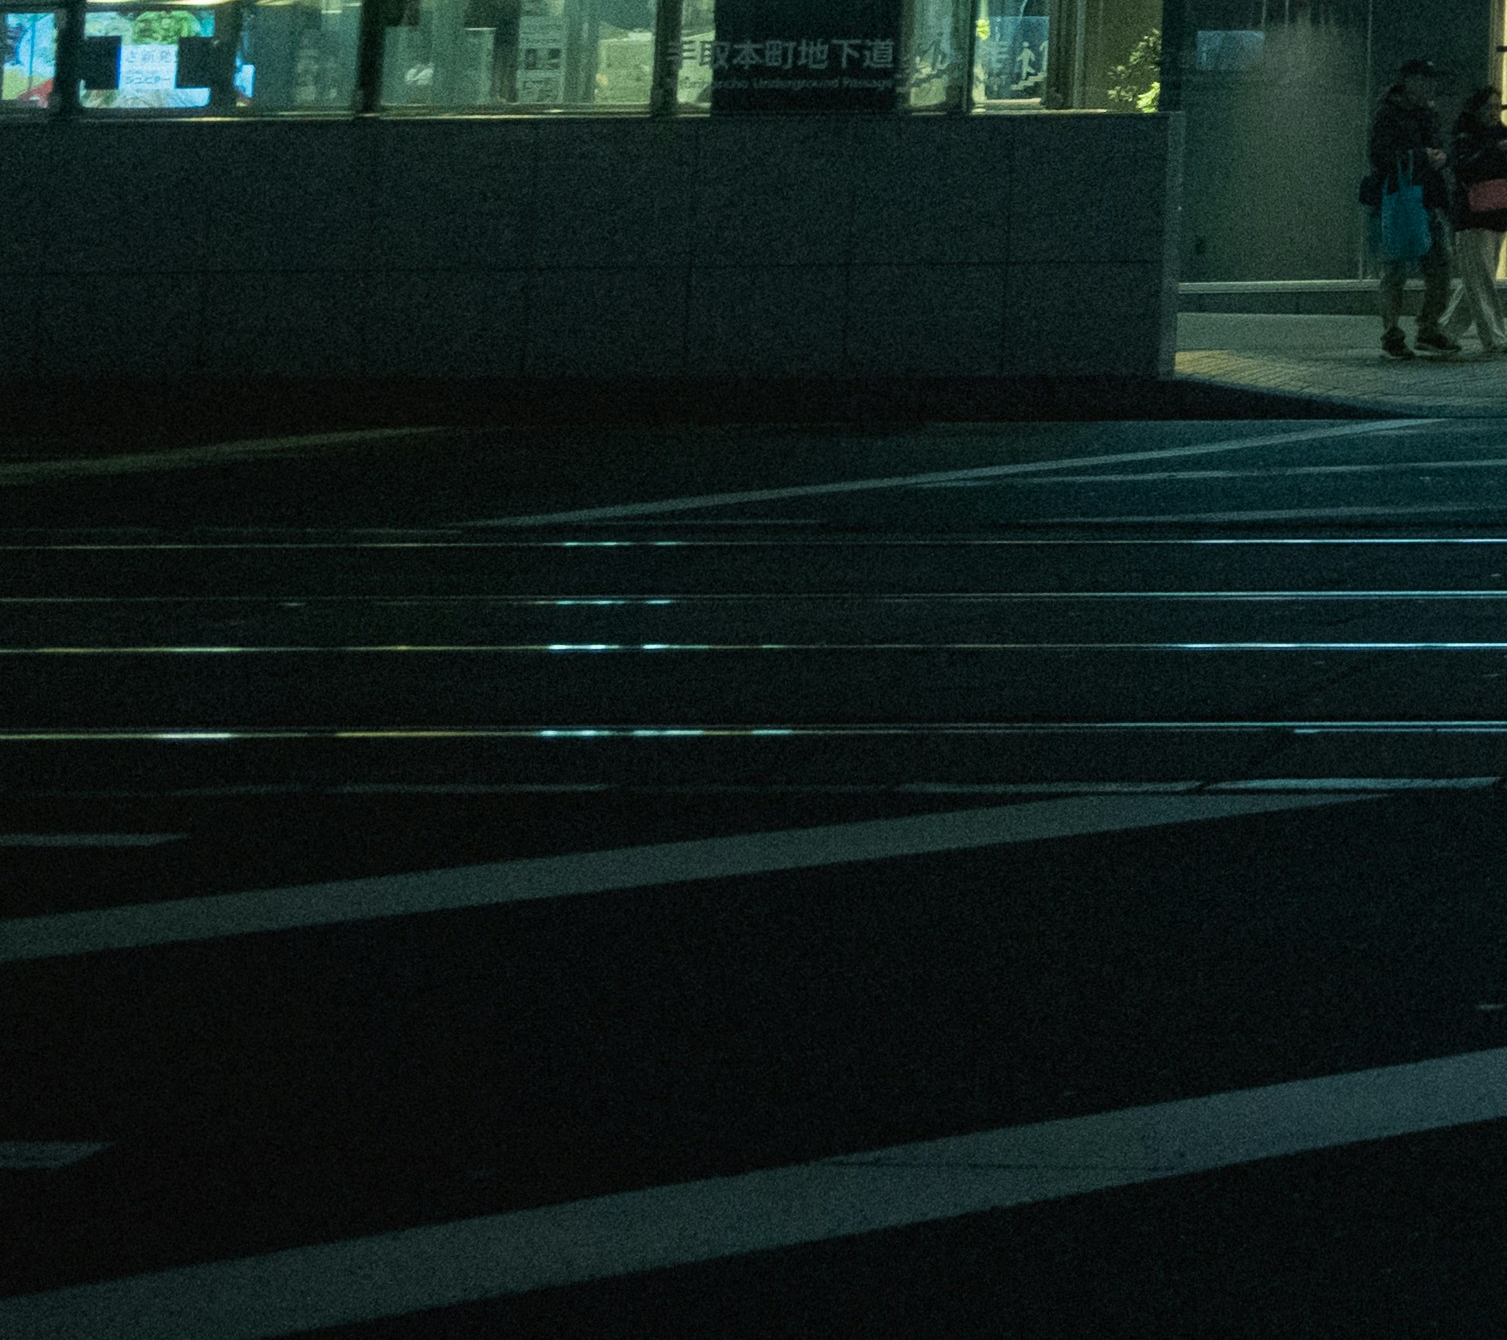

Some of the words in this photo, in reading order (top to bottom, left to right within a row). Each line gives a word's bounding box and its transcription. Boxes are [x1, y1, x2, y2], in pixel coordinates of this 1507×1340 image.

[667, 37, 896, 70] 手取本町地下道
